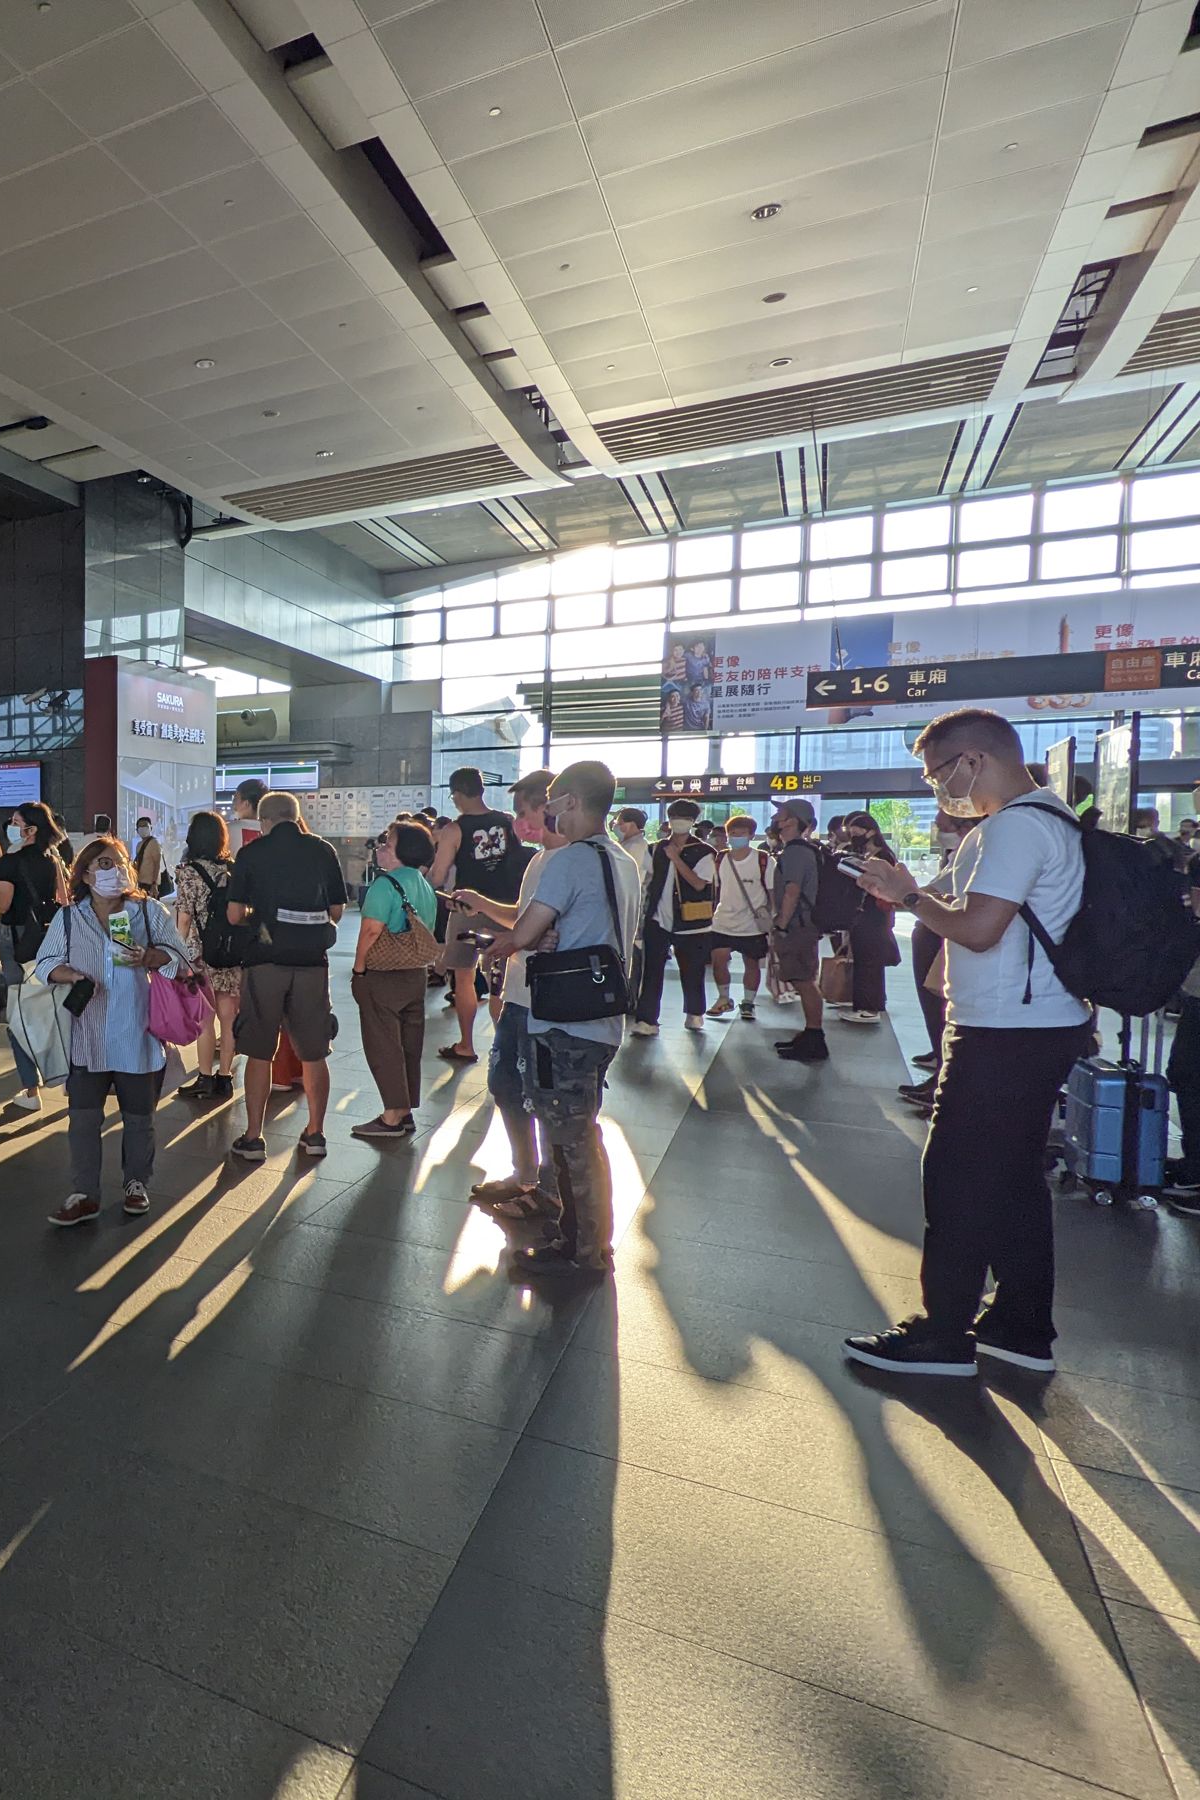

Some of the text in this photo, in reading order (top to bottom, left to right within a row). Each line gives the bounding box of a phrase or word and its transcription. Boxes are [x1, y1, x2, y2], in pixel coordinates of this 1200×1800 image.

[1094, 623, 1135, 639] 更像
[711, 655, 740, 669] 更像
[850, 668, 947, 694] 1-6 車廂
[710, 683, 771, 698] 星展隨行
[907, 687, 927, 697] Car
[156, 692, 184, 707] SAKURA
[769, 775, 799, 791] 4B
[802, 775, 822, 783] 出口
